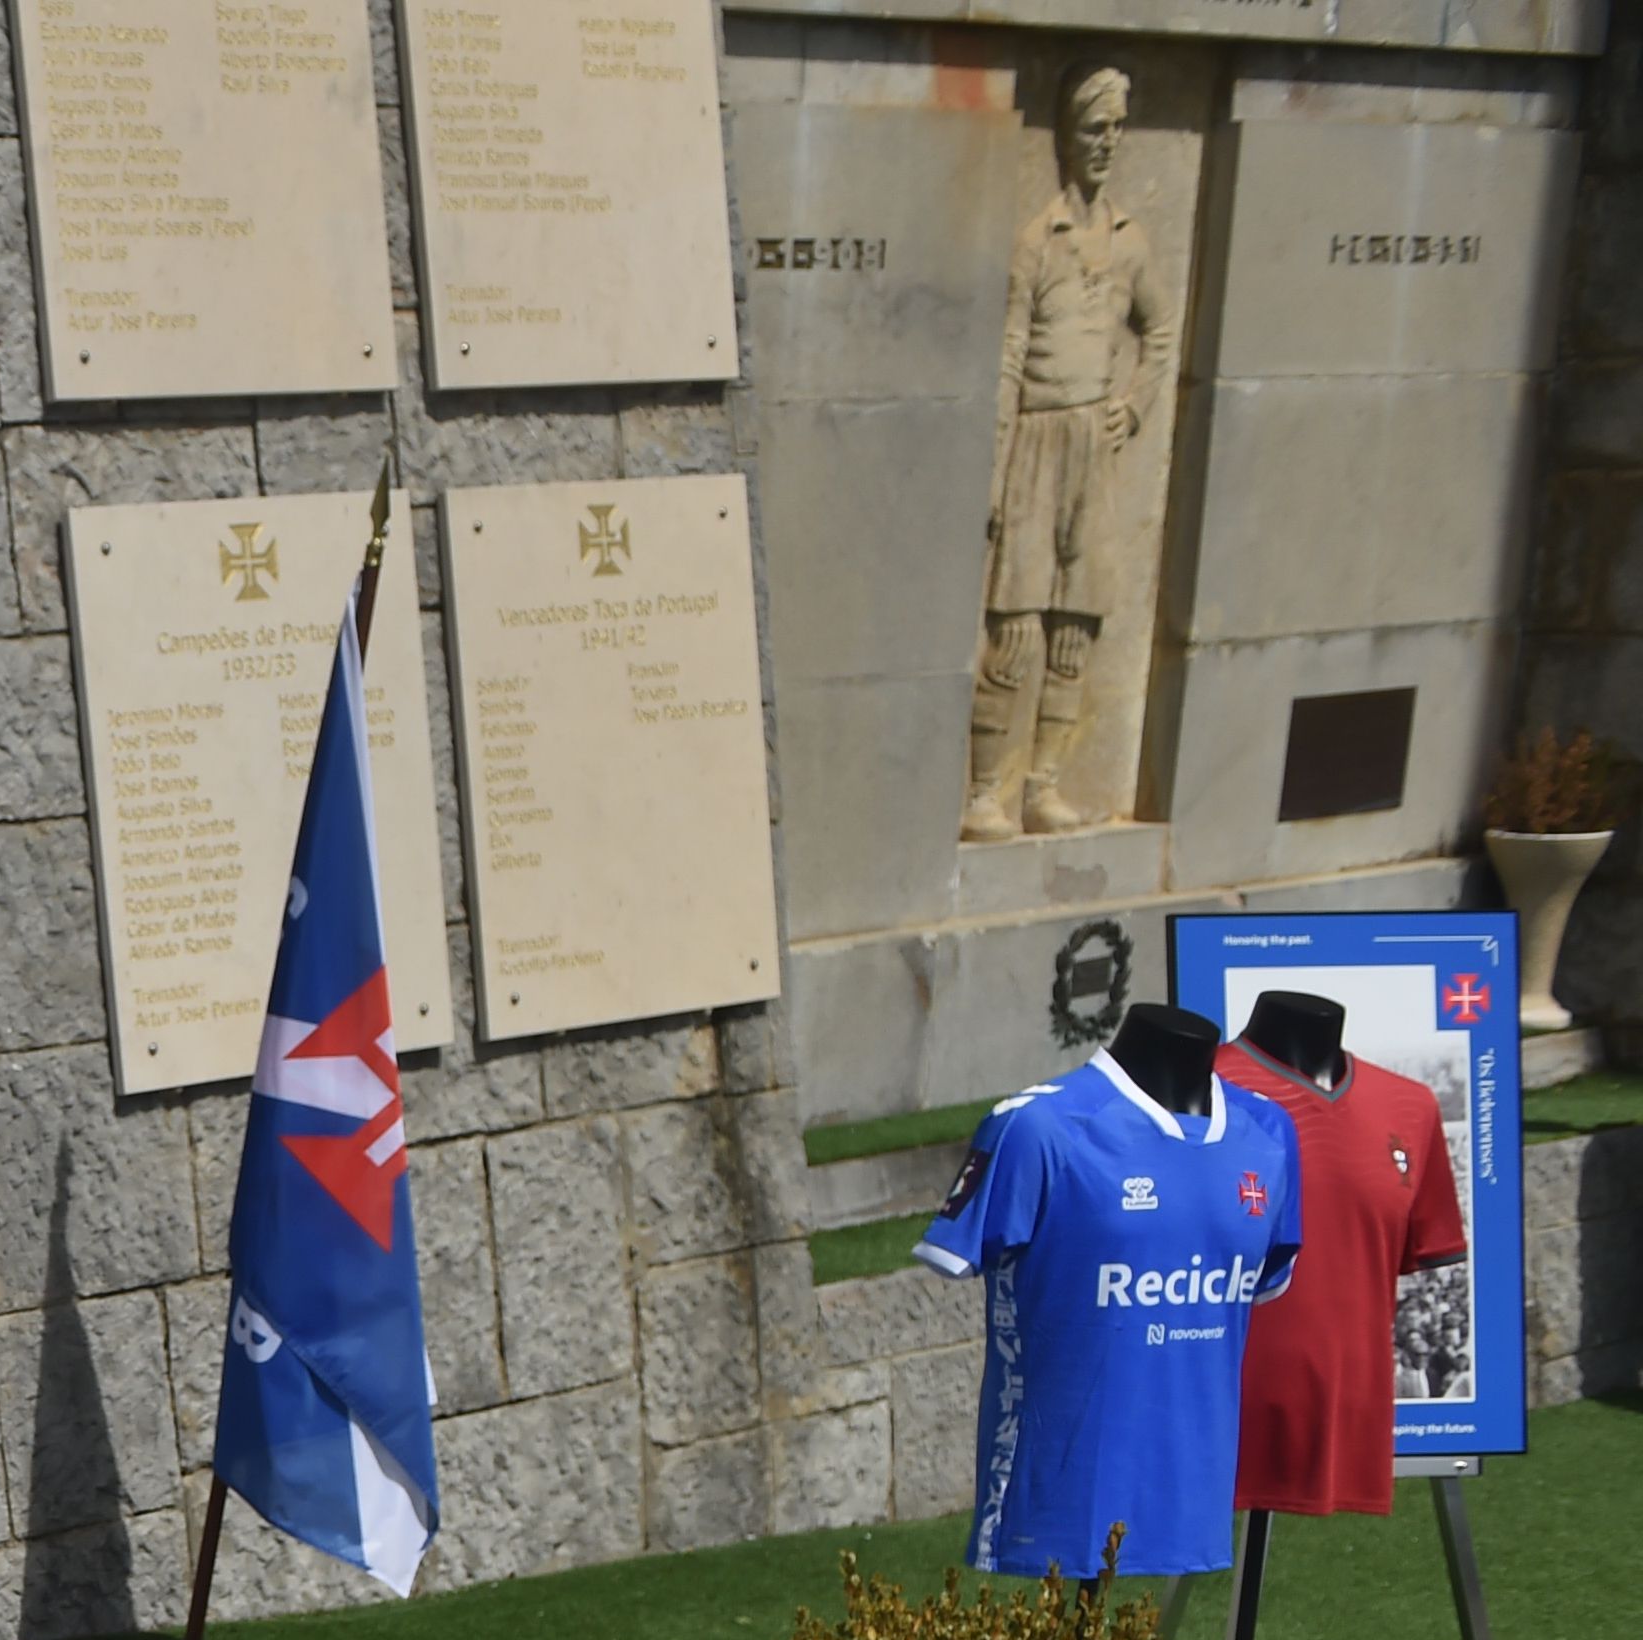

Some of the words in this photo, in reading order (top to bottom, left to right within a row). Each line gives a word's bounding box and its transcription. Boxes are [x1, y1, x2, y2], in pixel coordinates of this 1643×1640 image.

[156, 626, 250, 656] Campeões
[255, 625, 277, 647] de
[282, 621, 338, 646] Portug
[222, 652, 297, 682] 1932/33
[1270, 935, 1286, 945] the
[1169, 1326, 1227, 1341] novoverd
